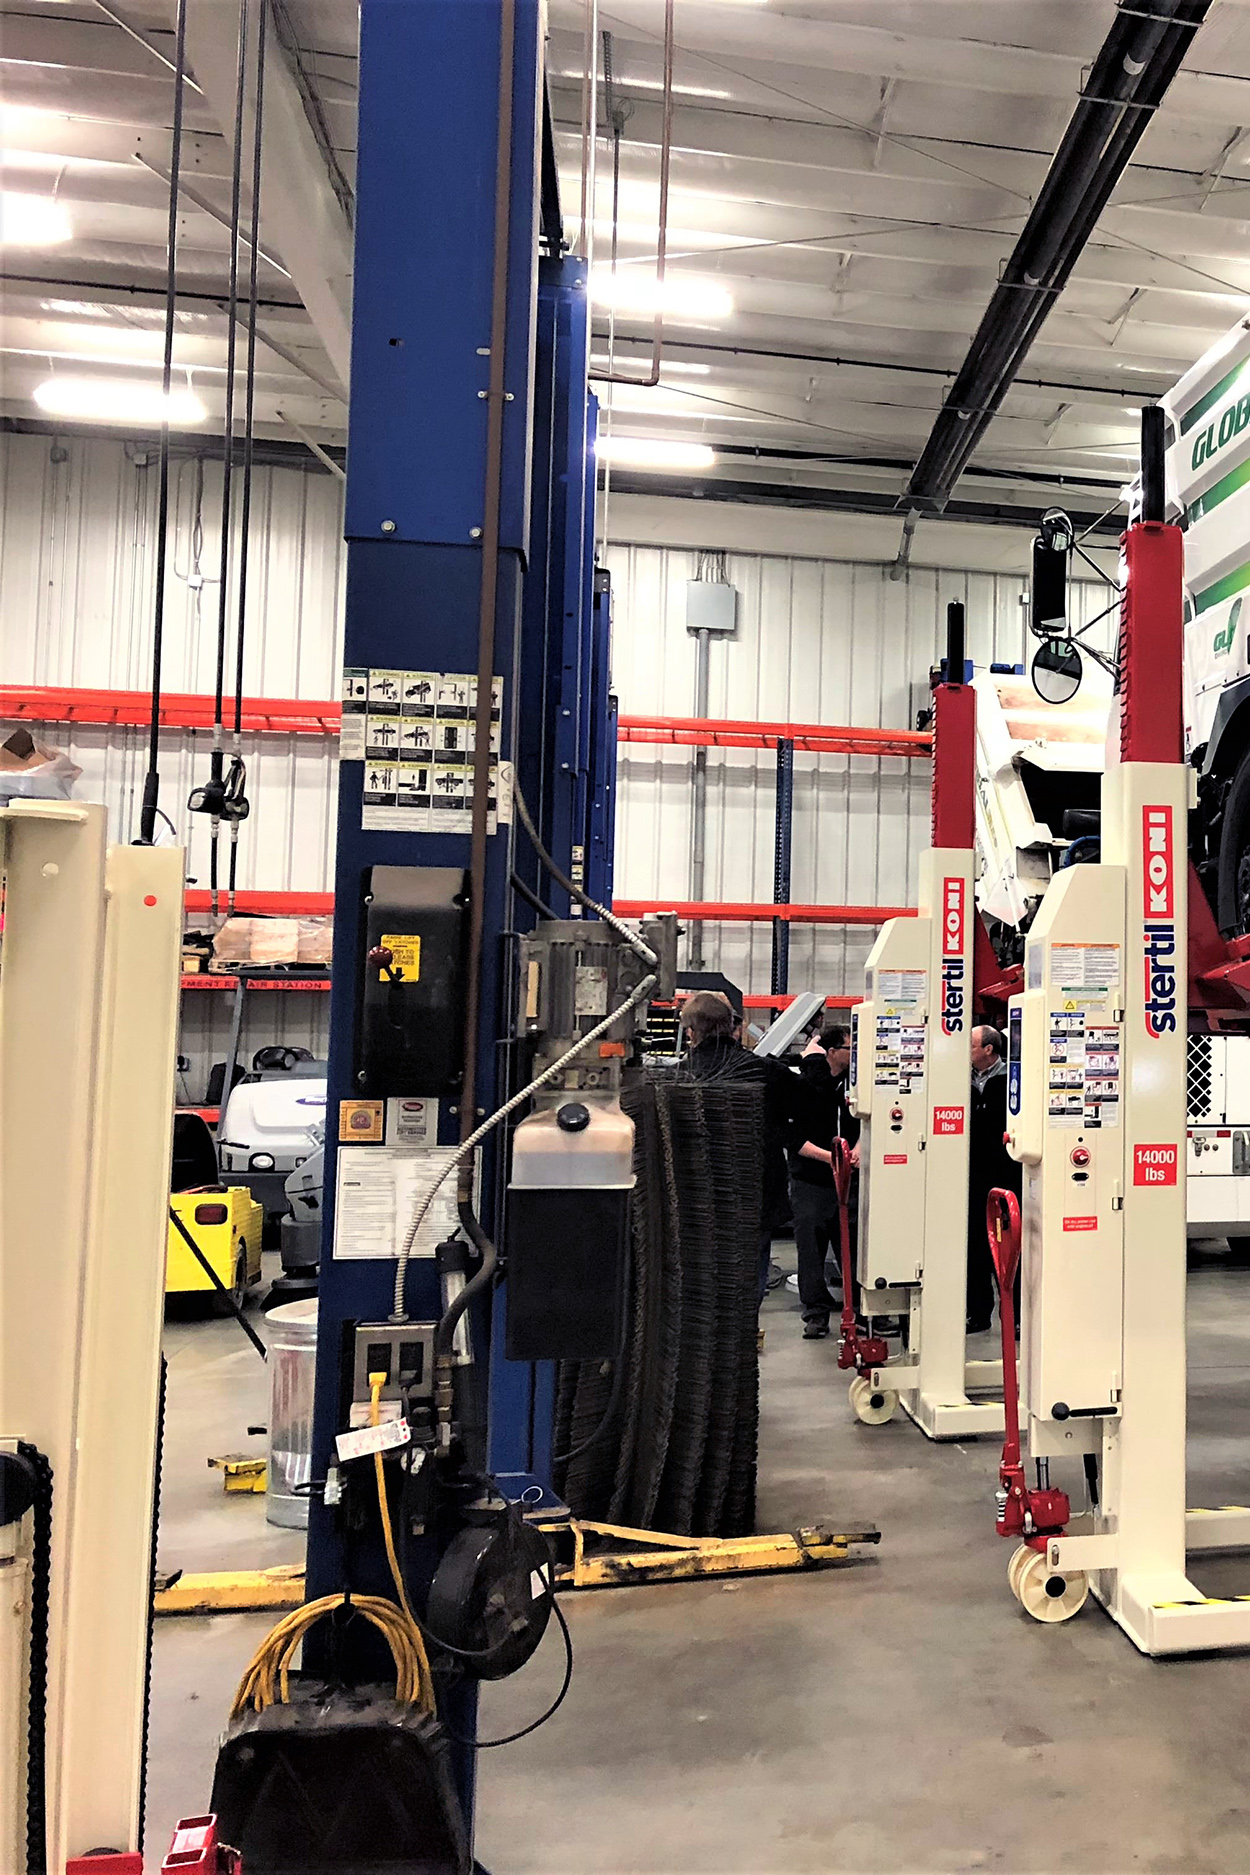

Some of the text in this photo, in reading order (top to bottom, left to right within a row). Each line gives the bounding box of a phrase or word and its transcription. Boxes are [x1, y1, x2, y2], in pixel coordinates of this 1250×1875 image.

[1149, 811, 1167, 912] KONI
[946, 881, 961, 951] KONI
[224, 979, 268, 988] REAIR
[272, 980, 322, 989] STATION
[1143, 924, 1176, 1039] stertil
[941, 958, 964, 1036] stertil
[935, 1110, 963, 1120] 14000
[941, 1121, 956, 1132] lbs
[1136, 1150, 1175, 1164] 14000
[1145, 1167, 1165, 1181] lbs
